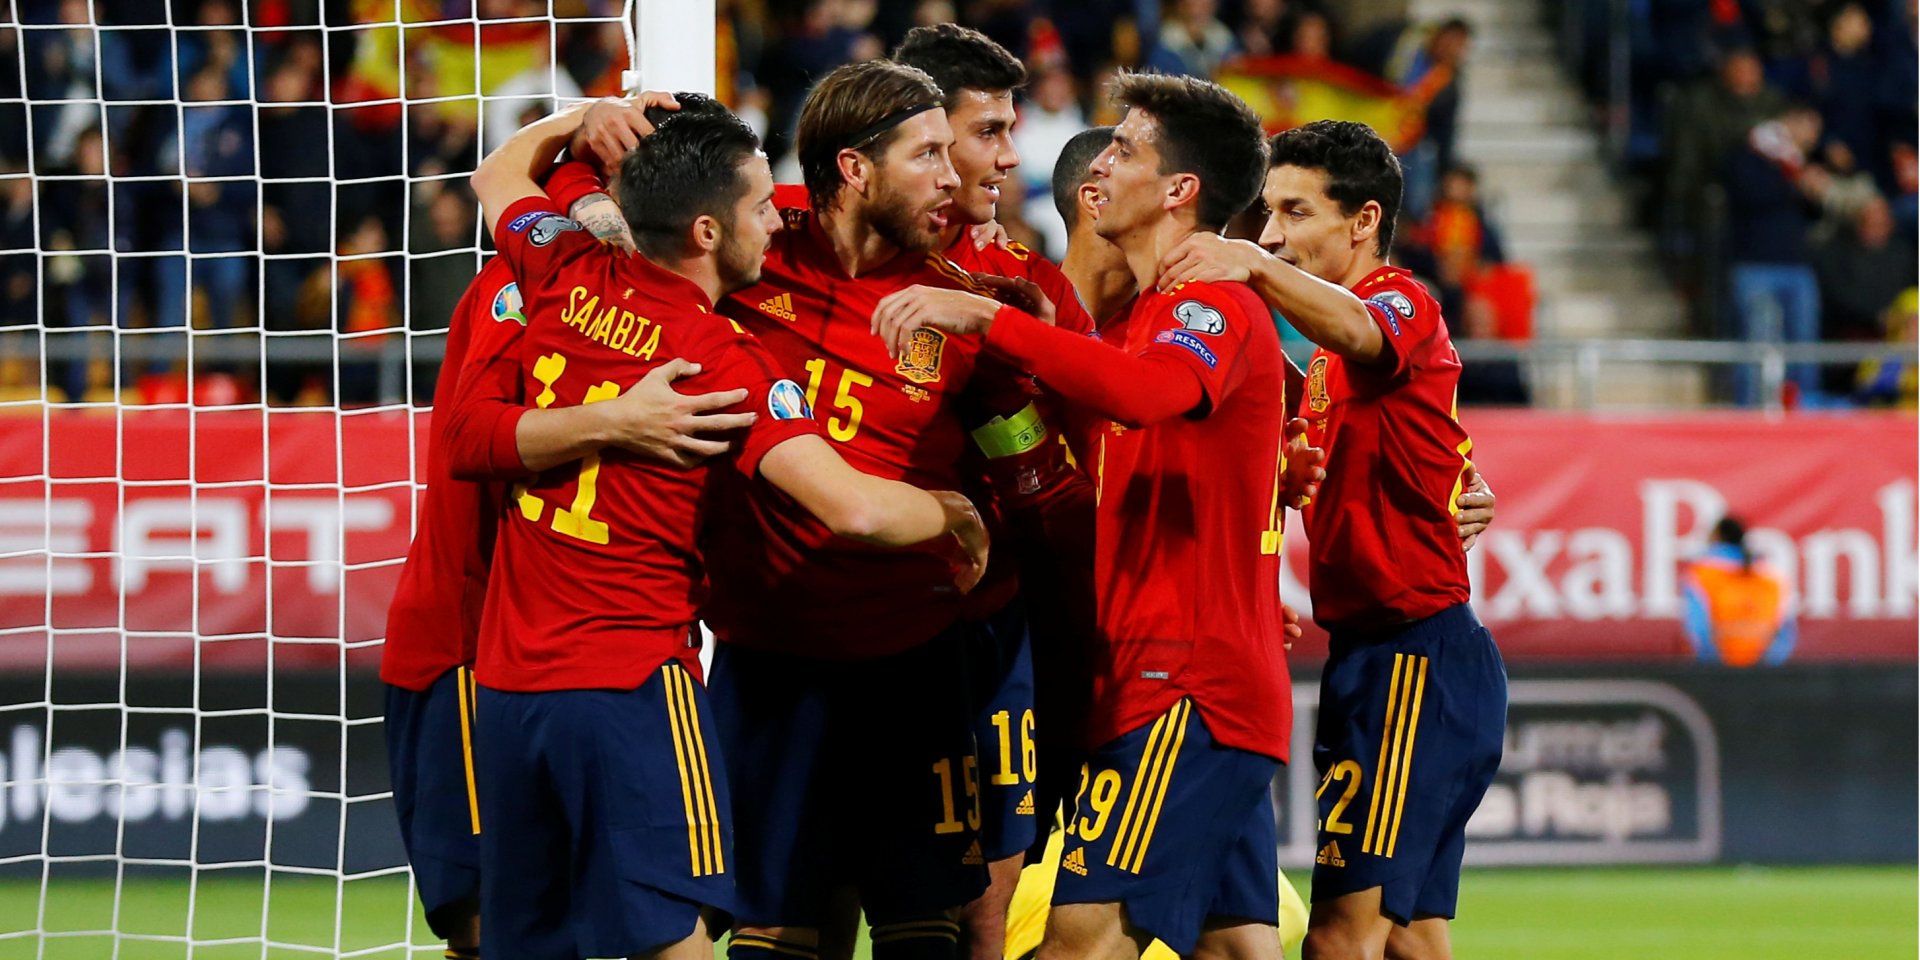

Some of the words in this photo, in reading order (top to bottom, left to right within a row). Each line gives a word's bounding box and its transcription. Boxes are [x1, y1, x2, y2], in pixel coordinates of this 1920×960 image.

[759, 302, 797, 322] adidas
[1175, 334, 1217, 365] RESPECT
[805, 358, 873, 442] 15
[0, 724, 311, 836] lesias
[991, 709, 1036, 785] 16
[933, 755, 981, 834] 15
[1316, 856, 1345, 868] adas
